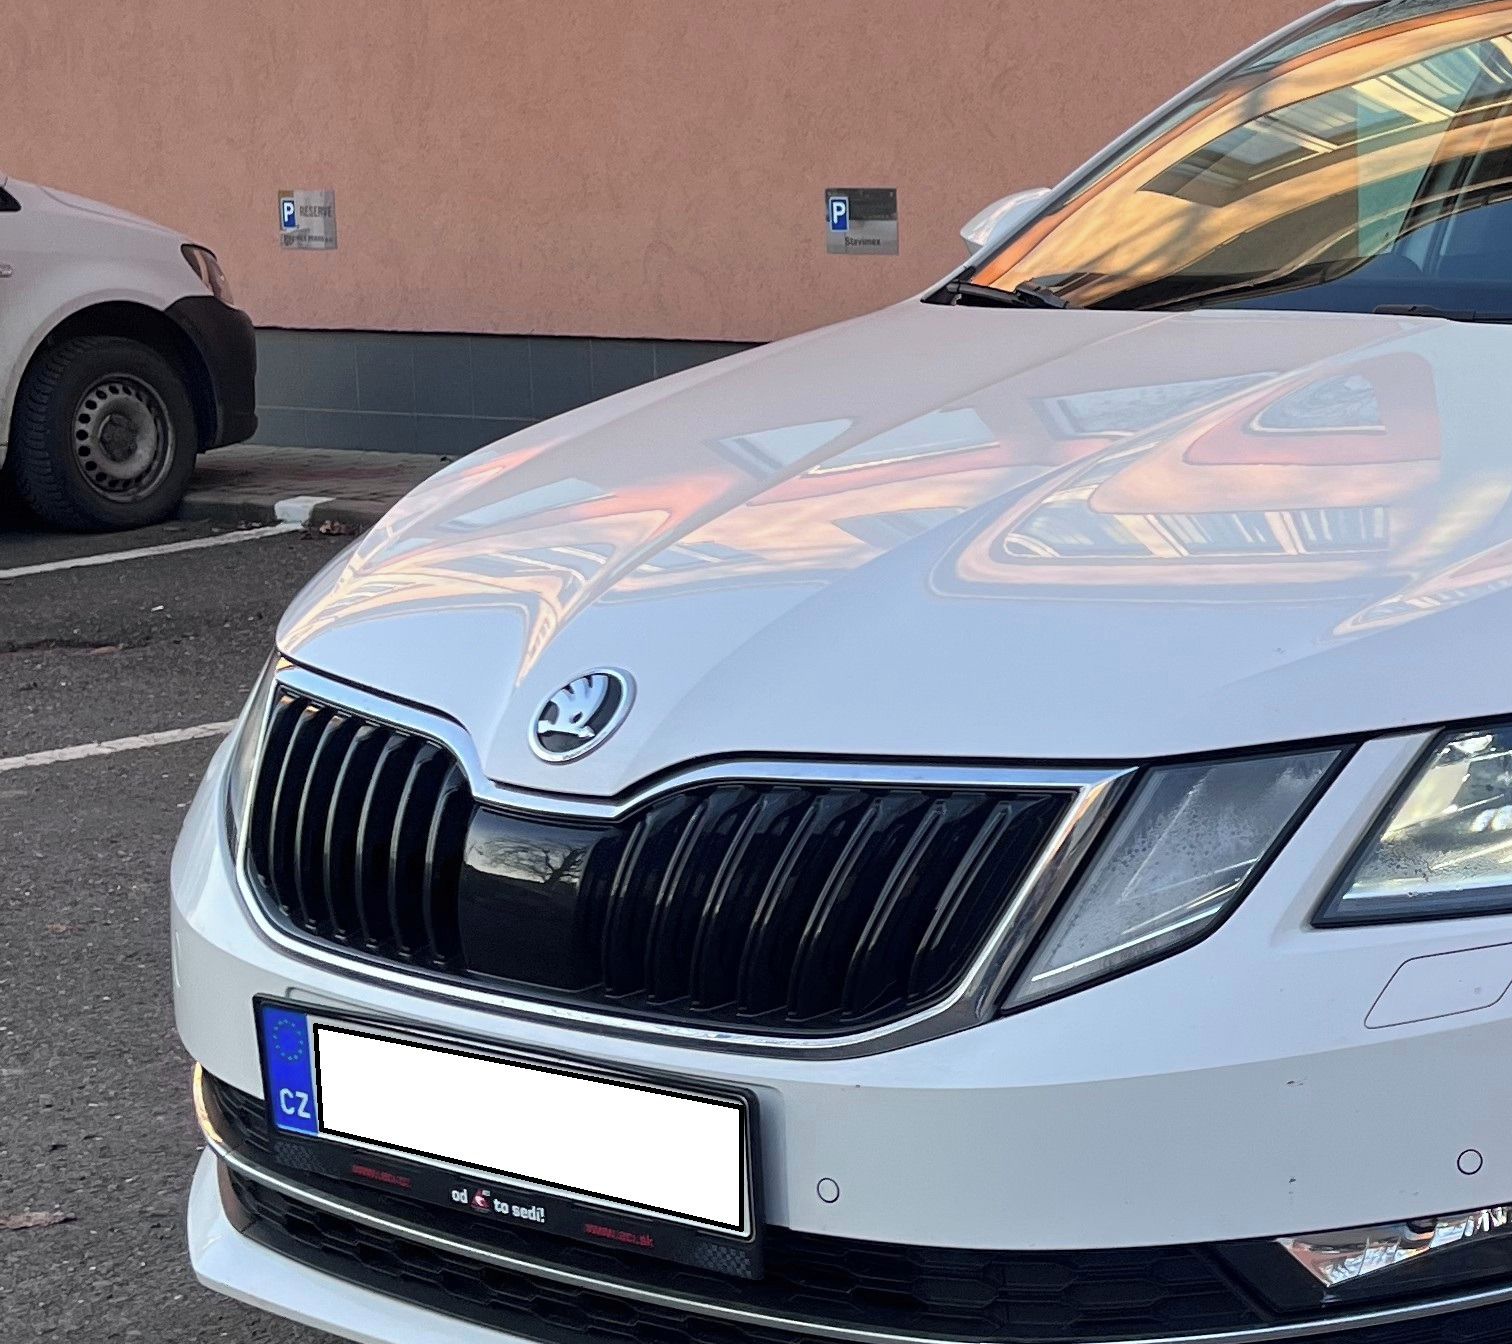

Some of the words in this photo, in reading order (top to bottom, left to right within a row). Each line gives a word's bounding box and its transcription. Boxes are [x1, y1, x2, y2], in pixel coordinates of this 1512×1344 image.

[284, 202, 294, 222] P
[833, 201, 846, 224] P
[280, 1088, 311, 1119] CZ
[451, 1188, 468, 1204] od
[493, 1198, 509, 1214] to
